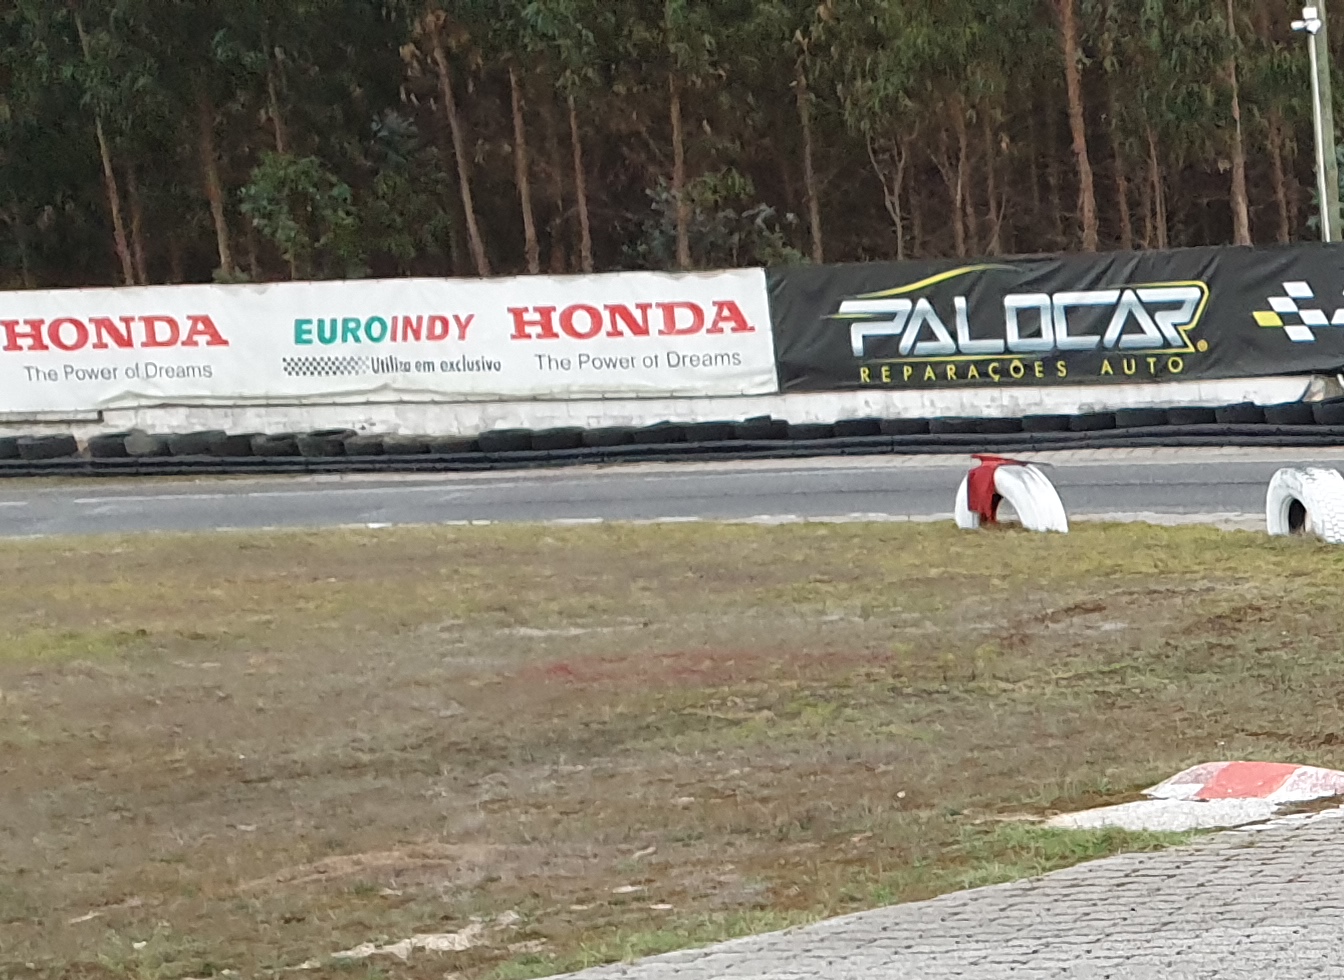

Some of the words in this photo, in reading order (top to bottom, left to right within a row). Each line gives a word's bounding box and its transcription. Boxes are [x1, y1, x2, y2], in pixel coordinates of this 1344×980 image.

[0, 314, 229, 352] HONDA
[294, 313, 475, 345] EUROINDY
[507, 300, 756, 340] HONDA
[838, 284, 1208, 357] PALOCAR
[24, 365, 58, 382] The
[63, 364, 118, 381] Power
[125, 362, 140, 379] of
[144, 362, 213, 379] Dreams
[371, 355, 411, 374] Utiliza
[415, 358, 435, 373] em
[440, 355, 502, 374] exclusivo
[534, 353, 571, 371] The
[578, 353, 635, 370] Power
[642, 352, 659, 368] of
[666, 350, 742, 367] Dreams
[860, 359, 1067, 383] REPARAÇÕES
[1101, 357, 1184, 376] AUTO
